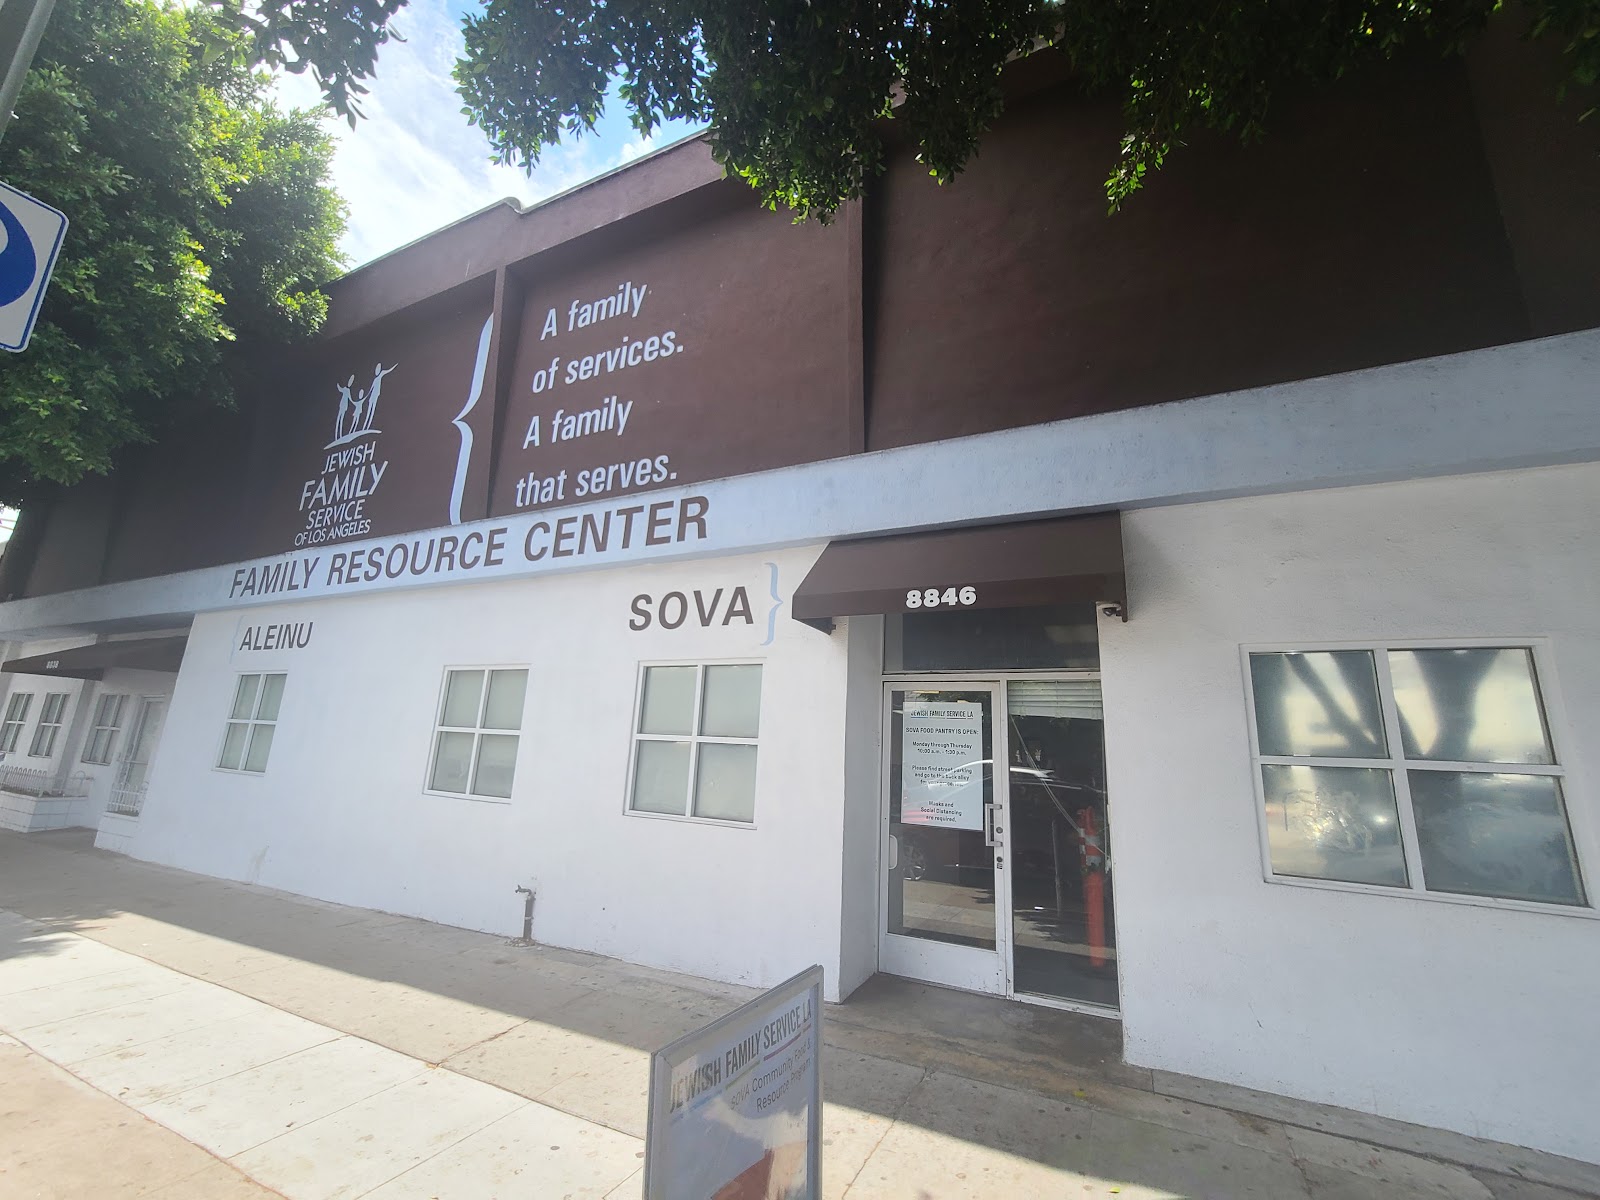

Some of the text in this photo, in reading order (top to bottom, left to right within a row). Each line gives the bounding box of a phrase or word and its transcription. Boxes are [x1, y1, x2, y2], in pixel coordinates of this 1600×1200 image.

[540, 281, 647, 340] A family
[532, 330, 684, 394] of services.
[523, 395, 633, 449] A family
[321, 441, 376, 475] JEWISH
[516, 454, 678, 507] that serves.
[299, 461, 388, 511] FAMILY
[294, 519, 371, 546] OF LOS ANGELES
[306, 499, 365, 529] SERVICE
[229, 495, 709, 599] FAMILY RESOURCE CENTER
[629, 586, 754, 631] SOVA
[905, 586, 977, 609] 8846
[239, 621, 313, 651] ALEINU
[670, 998, 812, 1114] JEWISH FAMILY SERVICE LA
[730, 1084, 750, 1110] SOVA
[752, 1057, 793, 1092] Community
[756, 1080, 789, 1112] Resource
